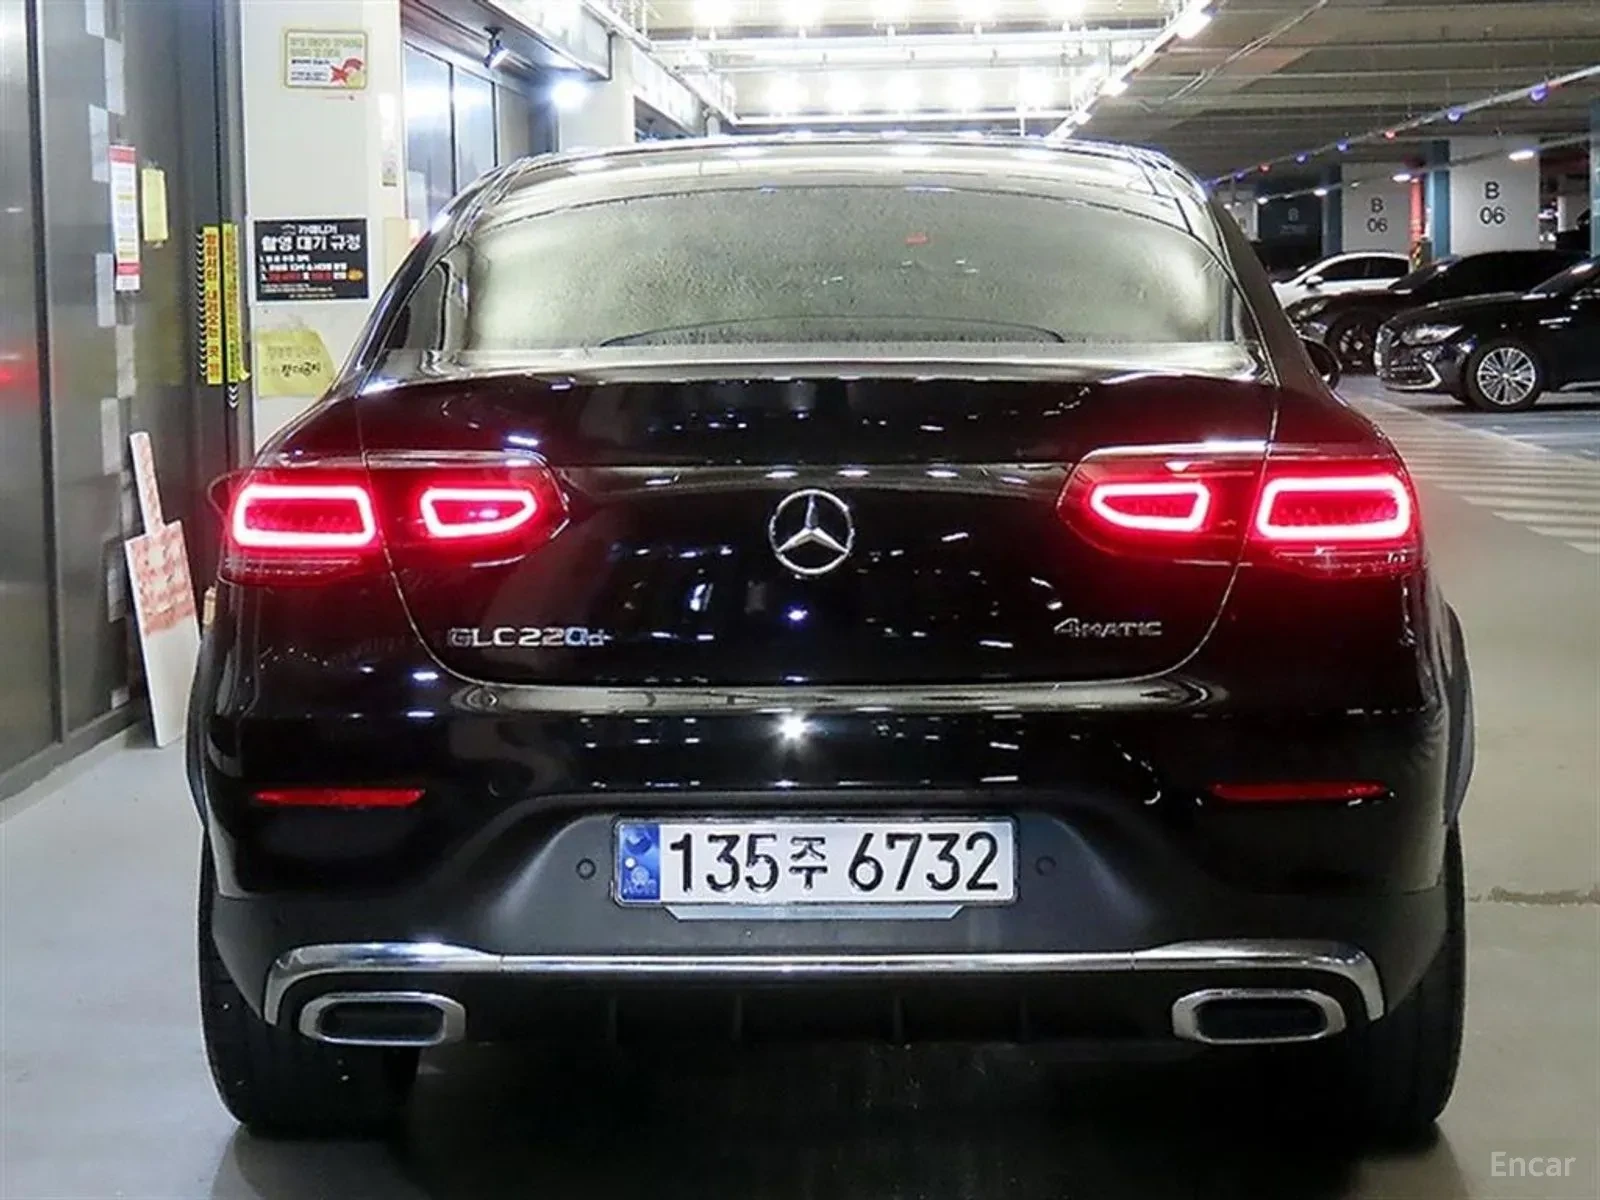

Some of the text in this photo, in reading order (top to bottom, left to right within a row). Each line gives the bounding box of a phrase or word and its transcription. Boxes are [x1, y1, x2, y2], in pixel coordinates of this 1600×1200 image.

[1485, 181, 1500, 199] B
[1371, 198, 1384, 212] B
[1480, 206, 1506, 224] 06
[1367, 218, 1388, 232] 06
[297, 235, 327, 251] 대기
[330, 234, 361, 251] 규정
[1053, 618, 1162, 637] 4MATIC
[670, 831, 999, 893] 135주 6732
